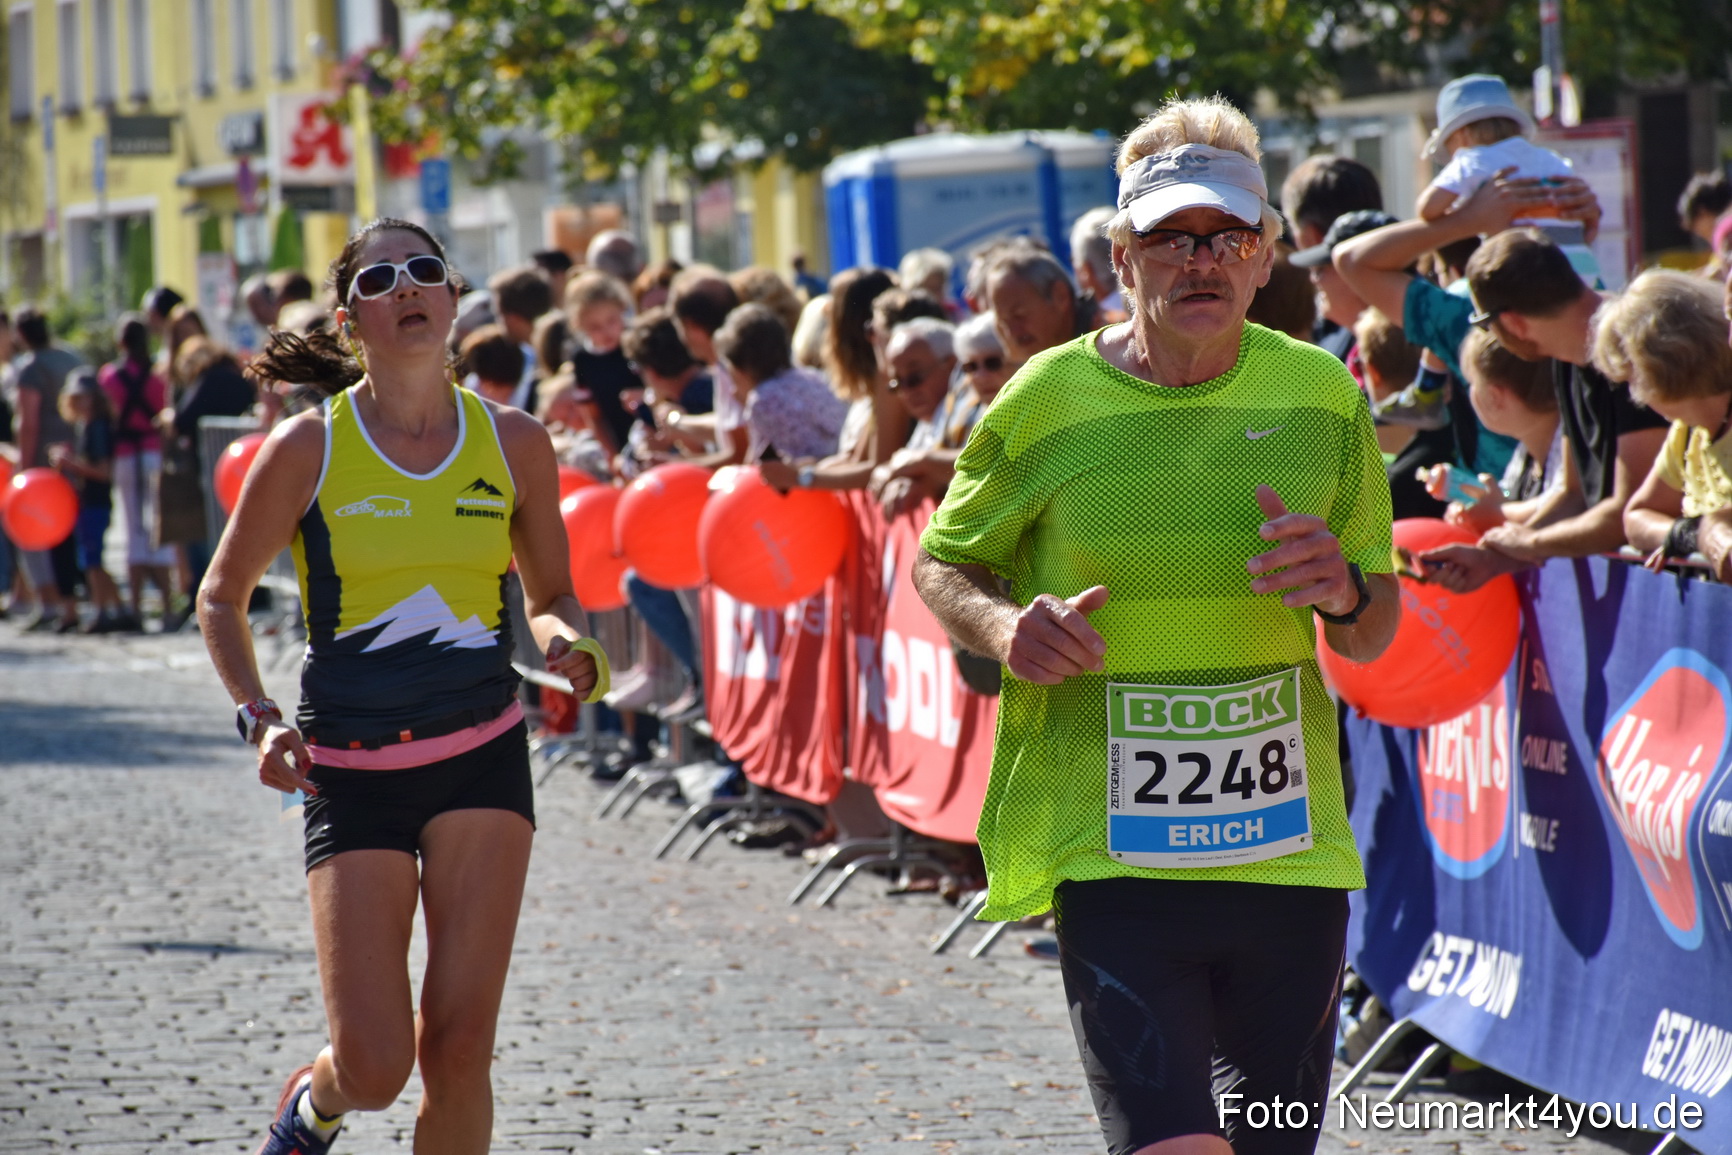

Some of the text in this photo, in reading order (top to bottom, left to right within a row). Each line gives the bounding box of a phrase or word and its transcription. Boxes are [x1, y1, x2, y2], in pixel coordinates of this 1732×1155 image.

[373, 508, 413, 518] MARX
[455, 507, 505, 520] Runners
[1125, 679, 1287, 734] BOCK
[1134, 739, 1289, 805] 2248
[1168, 817, 1264, 846] ERICH
[1407, 931, 1475, 997] GET
[1641, 1007, 1694, 1081] GET
